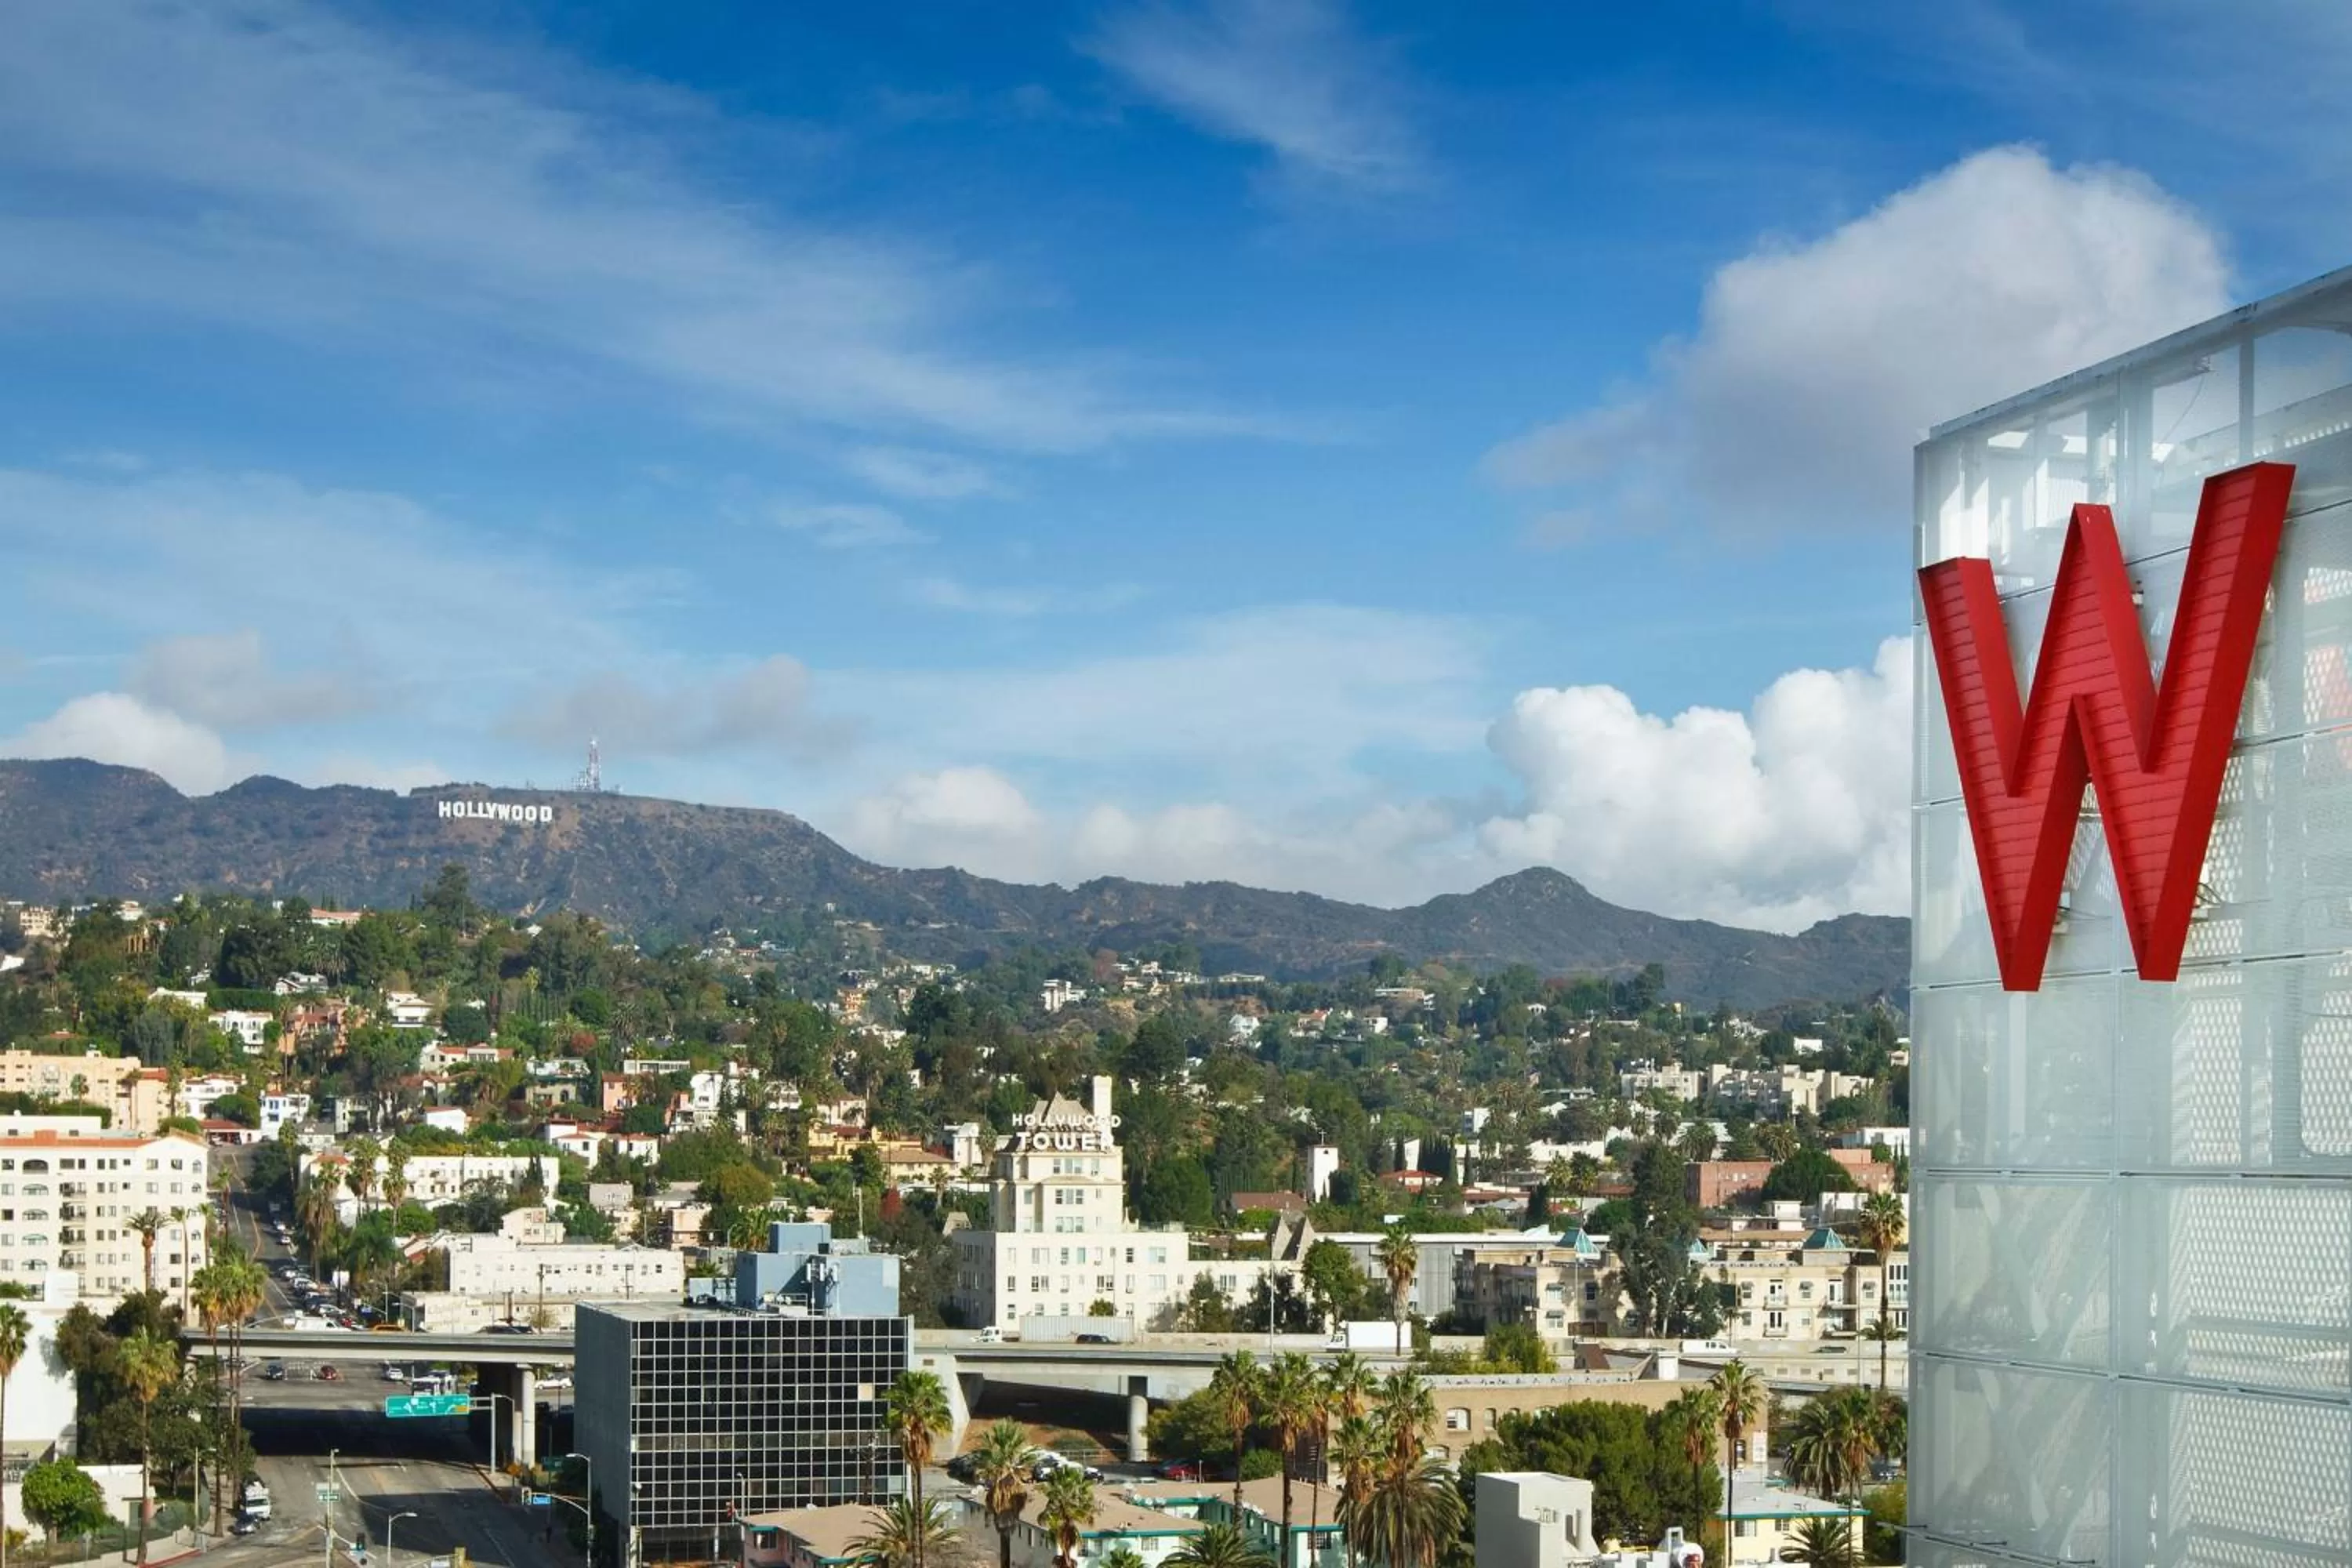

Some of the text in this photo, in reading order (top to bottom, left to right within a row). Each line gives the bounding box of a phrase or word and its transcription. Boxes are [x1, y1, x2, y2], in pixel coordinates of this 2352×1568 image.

[1918, 461, 2296, 991] W
[438, 800, 553, 822] HOLLYWOOD
[1012, 1113, 1121, 1127] HOLLYWOOD
[1016, 1131, 1114, 1150] TOWER
